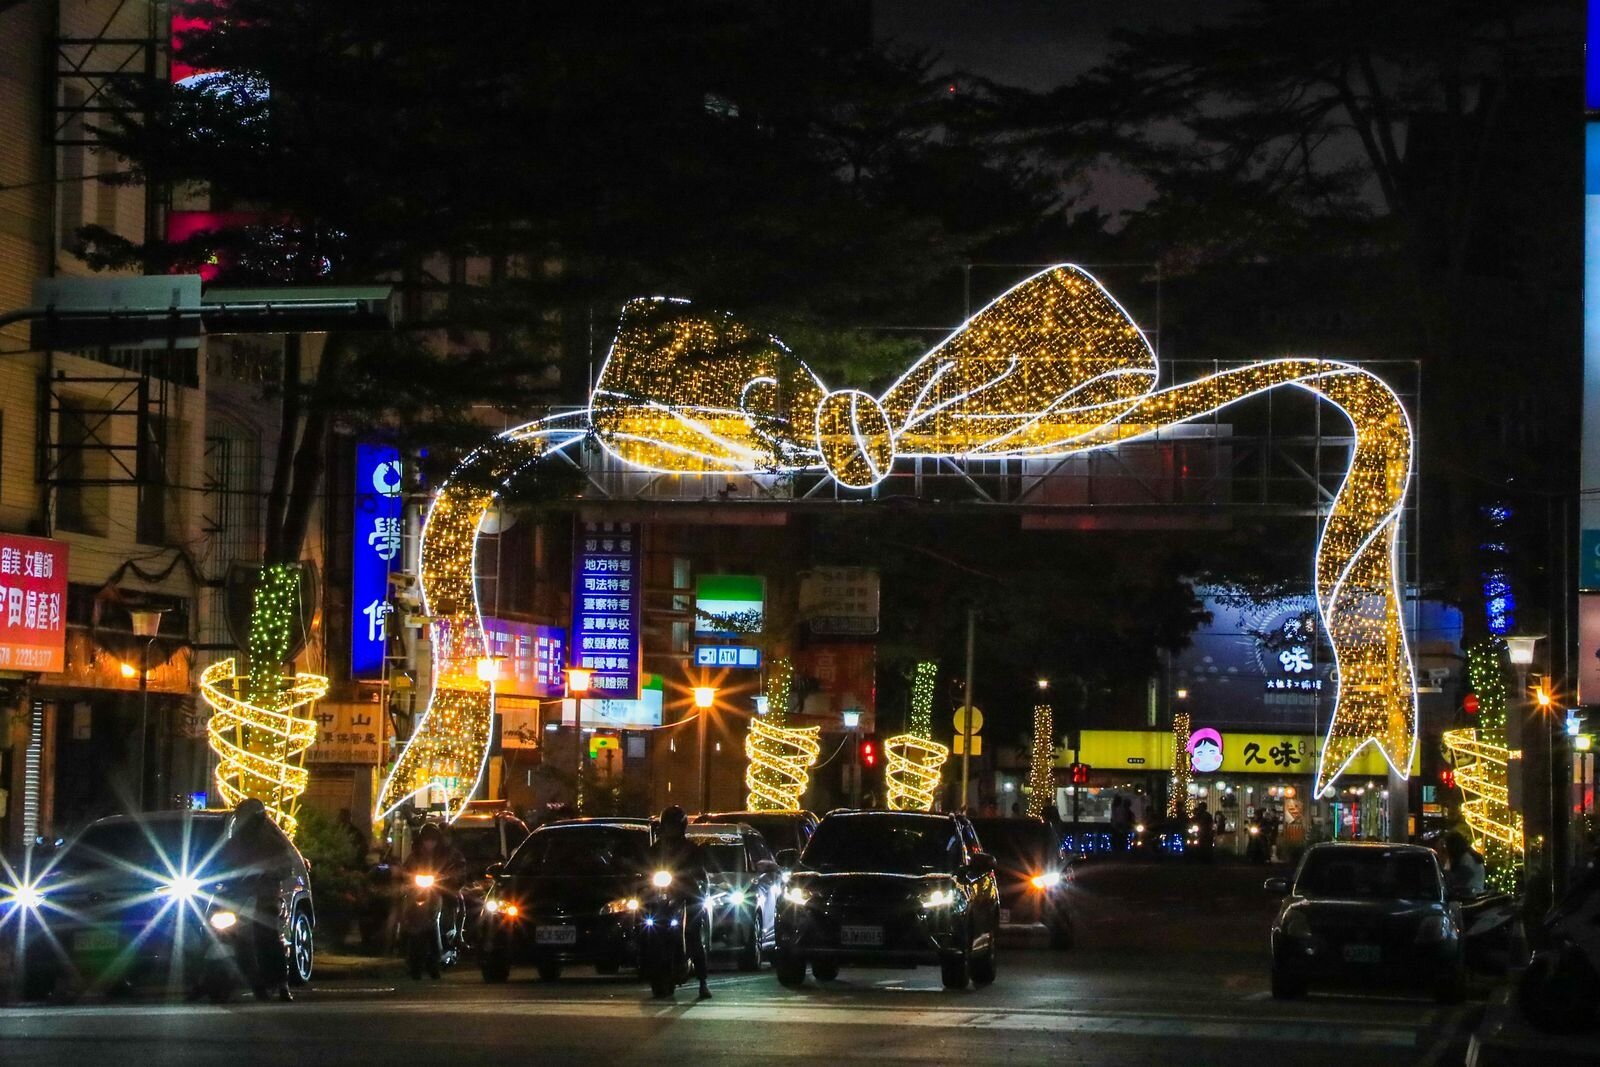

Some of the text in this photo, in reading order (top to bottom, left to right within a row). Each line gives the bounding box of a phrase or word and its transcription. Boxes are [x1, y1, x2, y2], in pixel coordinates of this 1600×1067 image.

[1, 546, 54, 579] 留美 女醫師
[584, 558, 631, 571] 地方特考
[584, 578, 631, 591] 司法特考
[583, 597, 630, 611] 警察特考
[583, 617, 630, 630] 警專學校
[582, 656, 629, 669] 國營事業
[720, 650, 736, 662] ATM
[315, 712, 371, 727] 中山
[1243, 741, 1301, 767] 久味
